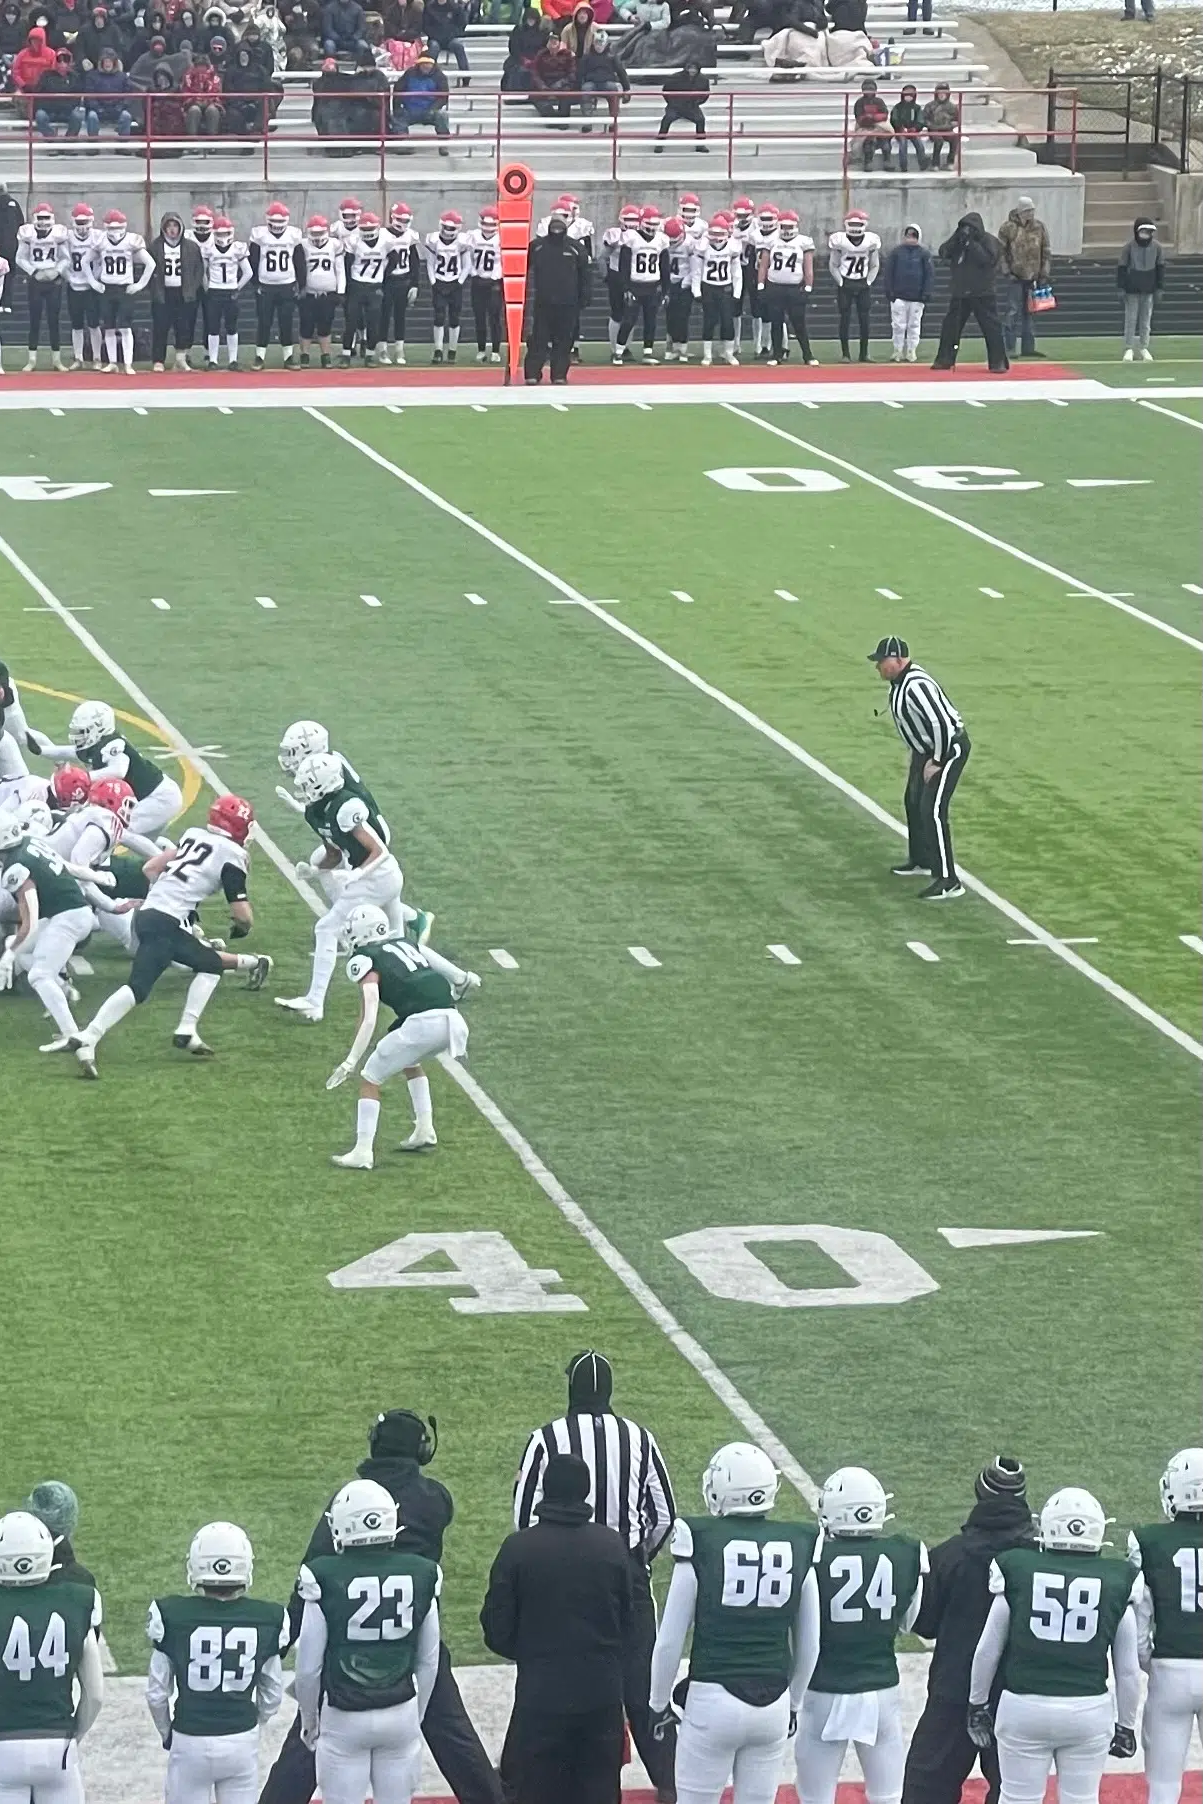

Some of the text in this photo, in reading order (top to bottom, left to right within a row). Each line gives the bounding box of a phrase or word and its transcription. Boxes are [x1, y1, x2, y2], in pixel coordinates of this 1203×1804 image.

[104, 255, 127, 275] 80
[266, 250, 289, 272] 60
[309, 258, 331, 273] 79
[360, 258, 383, 279] 77
[436, 255, 458, 276] 24
[474, 249, 495, 272] 76
[636, 252, 658, 273] 68
[707, 260, 728, 281] 20
[773, 251, 797, 273] 64
[846, 255, 866, 277] 74
[219, 262, 227, 283] 1
[167, 837, 214, 883] 22
[382, 941, 429, 972] 14
[721, 1539, 793, 1608] 68
[1173, 1547, 1203, 1613] 1
[829, 1554, 896, 1622] 24
[347, 1575, 414, 1641] 23
[1029, 1572, 1101, 1643] 58
[2, 1611, 70, 1682] 44
[187, 1626, 259, 1692] 83
